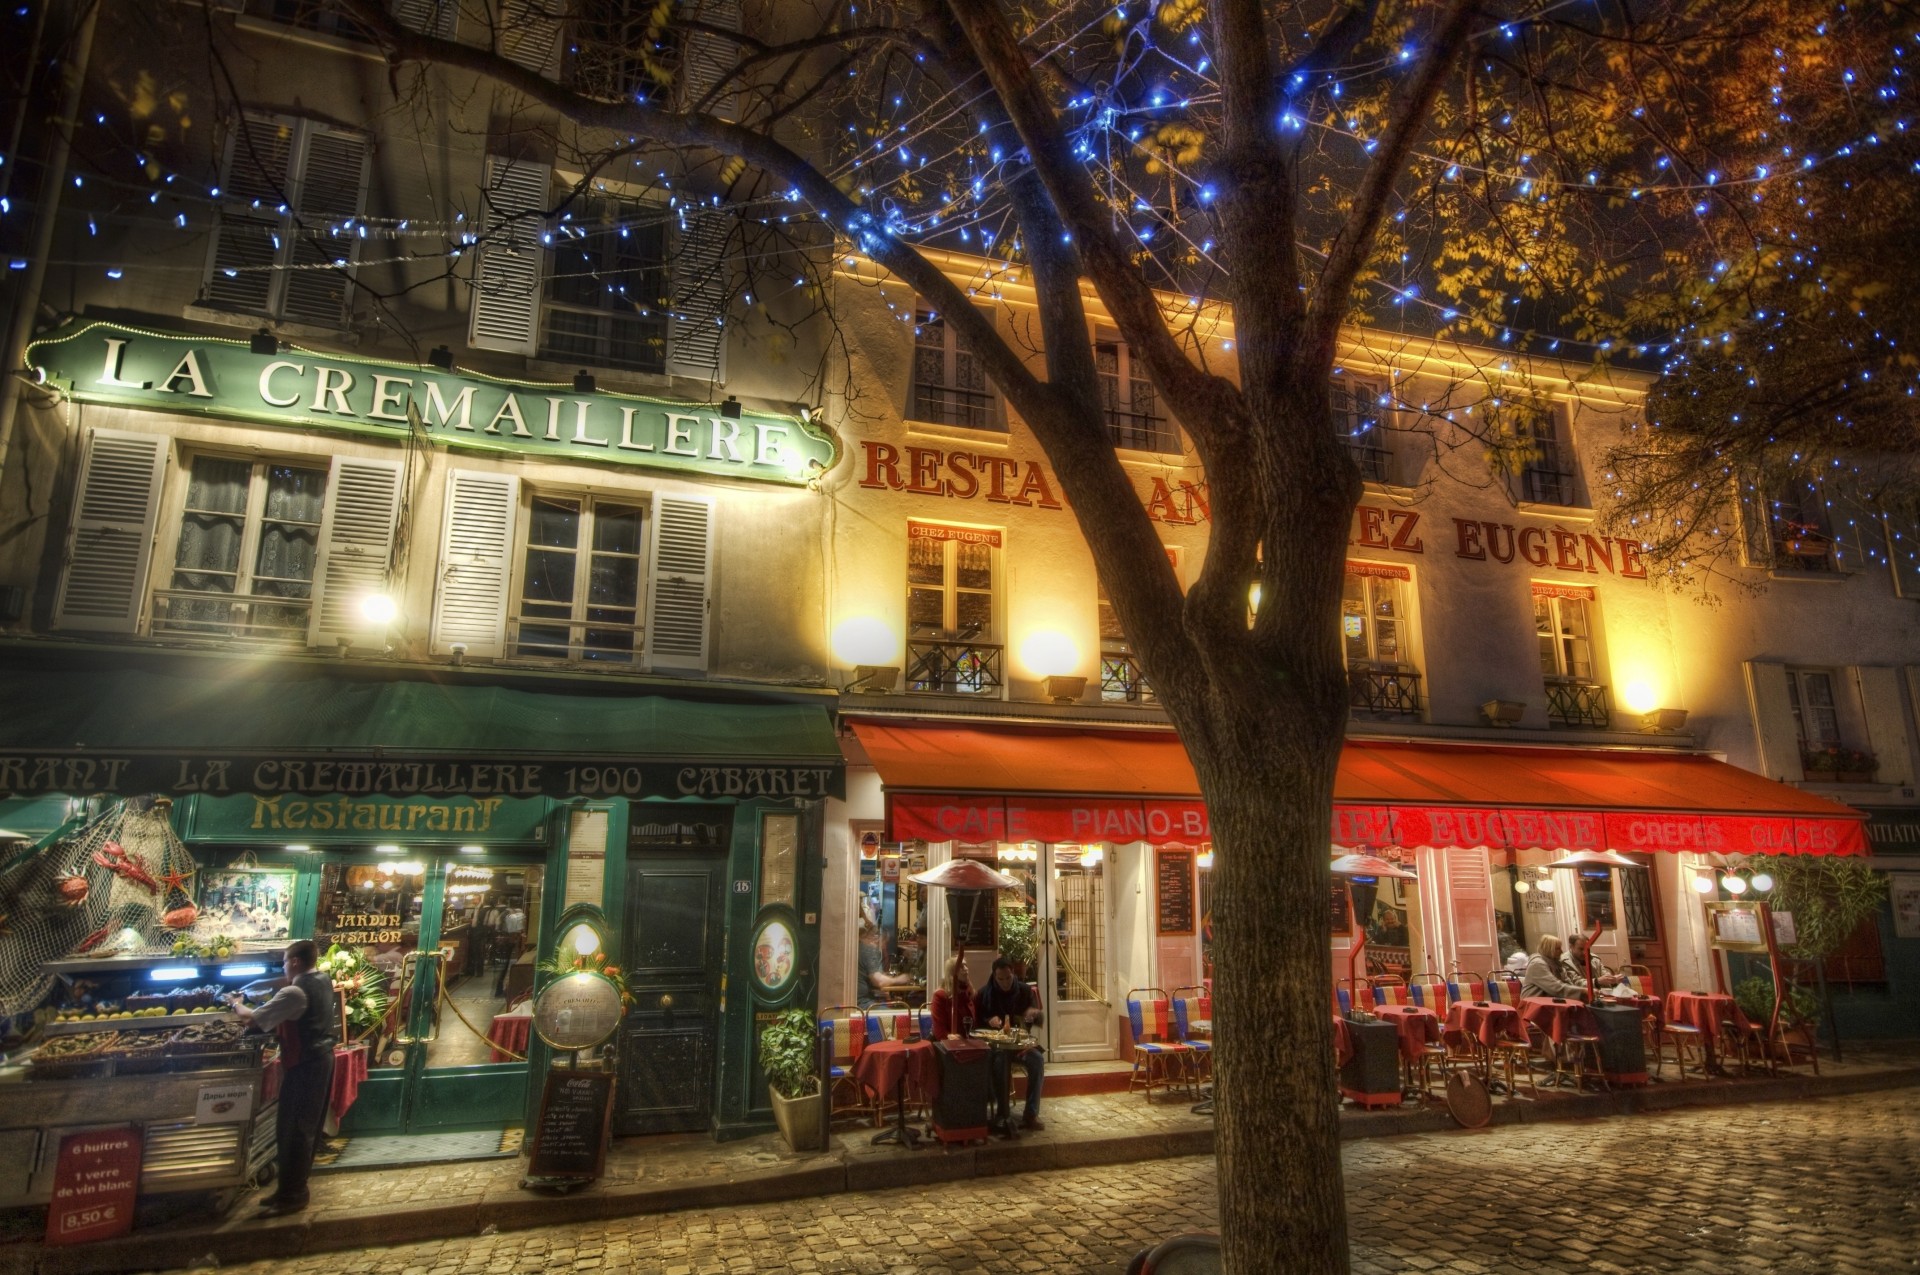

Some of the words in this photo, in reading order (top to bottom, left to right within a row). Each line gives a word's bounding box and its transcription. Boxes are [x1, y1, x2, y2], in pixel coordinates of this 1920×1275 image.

[96, 336, 213, 399] LA
[259, 360, 793, 467] CREMAILLERE
[911, 526, 946, 540] CHEZ
[948, 529, 999, 545] EUGENE
[1347, 505, 1424, 555] EZ
[1452, 515, 1648, 580] EUGÈNE
[1345, 565, 1366, 574] HEZ
[172, 759, 231, 792] LA
[253, 760, 543, 795] CREMAILLERE
[564, 766, 642, 794] 1900
[677, 767, 833, 797] CABARET
[937, 805, 1028, 835] CAFE
[1072, 808, 1212, 837] PIANO-B
[1427, 811, 1598, 847] EUGENE
[1629, 819, 1723, 848] CREPES
[1751, 823, 1839, 850] GLACES
[336, 914, 401, 929] JARDIN
[347, 931, 402, 944] SALON
[72, 1144, 82, 1155] 6
[75, 1171, 82, 1181] 1
[85, 1168, 120, 1181] verre
[57, 1186, 74, 1198] de
[76, 1183, 96, 1196] vin
[98, 1180, 133, 1193] blanc
[66, 1210, 101, 1228] 8,50
